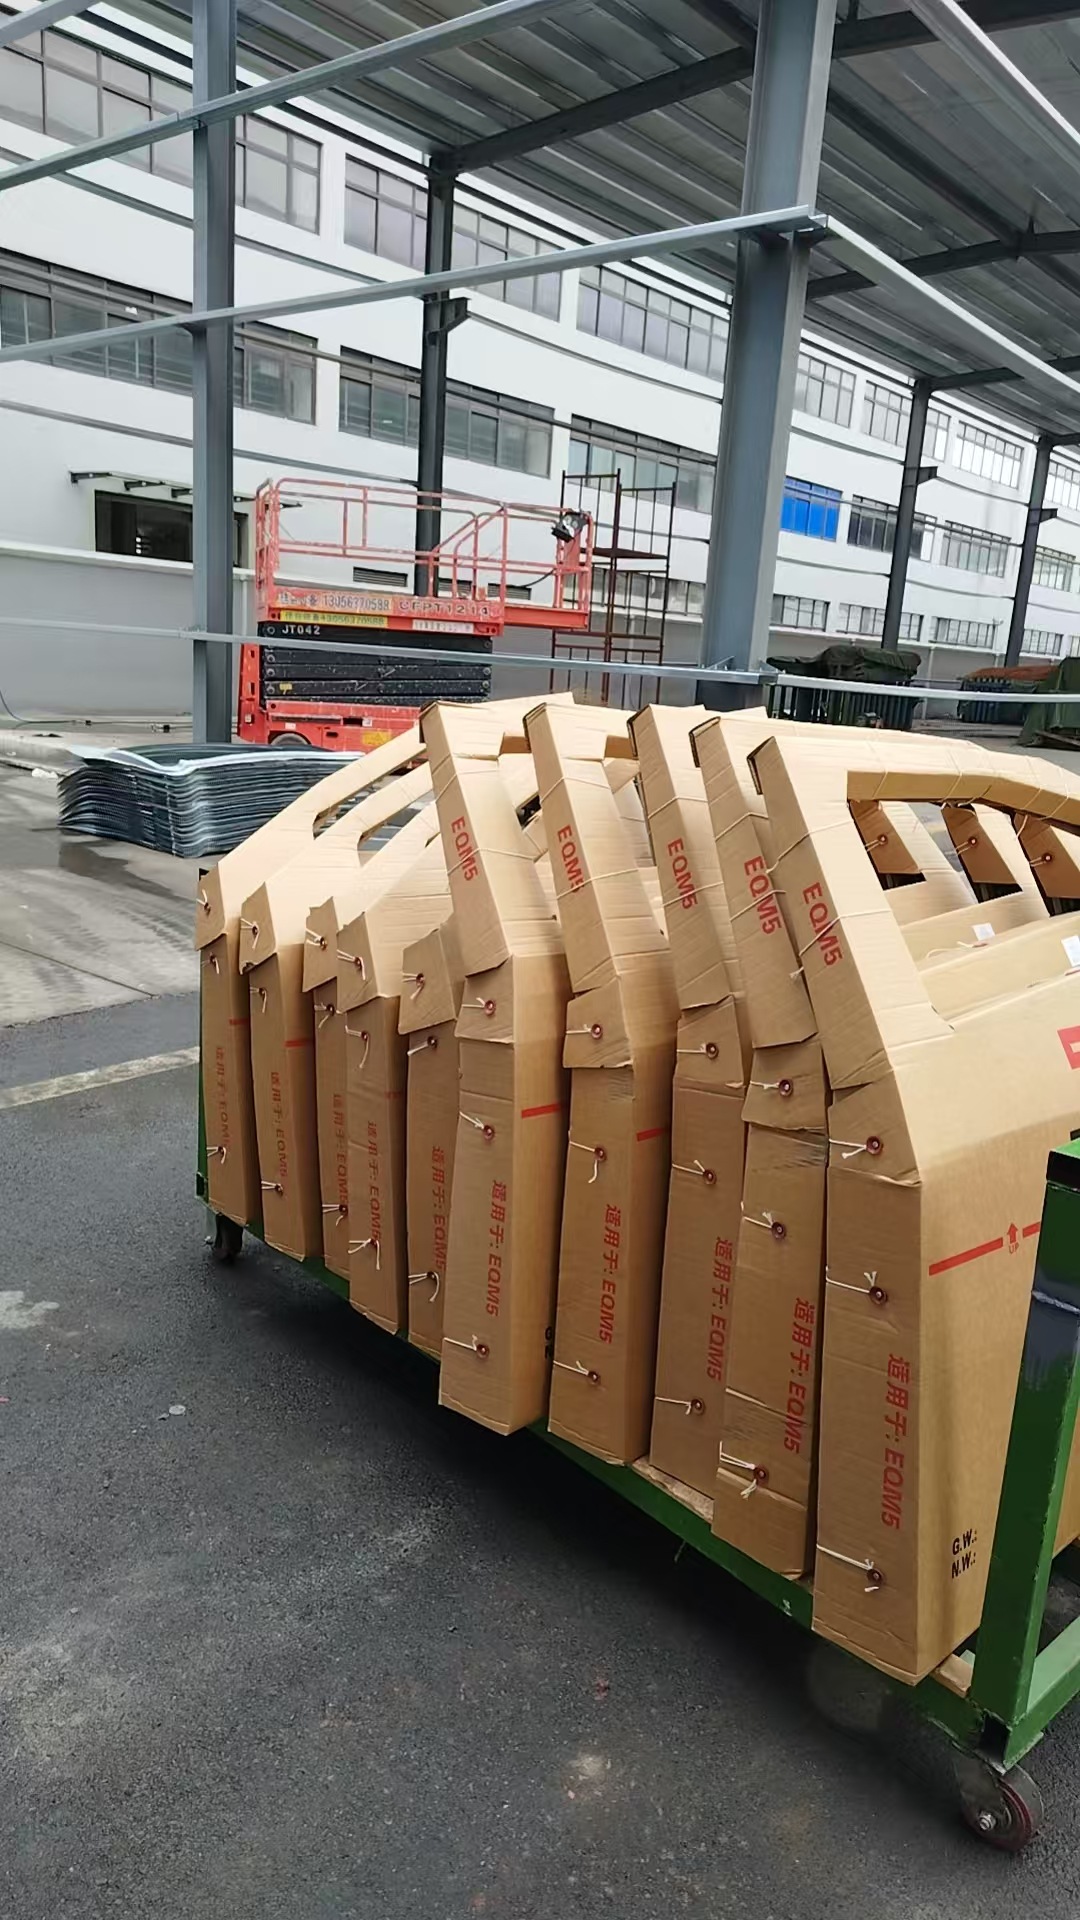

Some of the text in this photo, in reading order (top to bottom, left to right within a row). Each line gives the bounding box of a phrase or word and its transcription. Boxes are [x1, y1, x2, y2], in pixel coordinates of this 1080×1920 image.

[282, 624, 320, 635] JT042
[451, 816, 479, 881] EQM5
[667, 838, 698, 909] EQM5
[744, 855, 782, 935] EQM5
[803, 882, 844, 966] EQM5
[431, 1146, 447, 1271] 适用于: EQM5
[486, 1180, 508, 1317] 适用于: EQM5
[1007, 1241, 1020, 1254] UP
[599, 1204, 621, 1344] 适用于: EQM5
[707, 1236, 733, 1383] 适用于: EQM5
[783, 1297, 815, 1454] 适用于: EQM5
[881, 1354, 910, 1530] 适用于: EQM5
[951, 1551, 976, 1579] N.W.:
[952, 1528, 977, 1556] G.W.:
